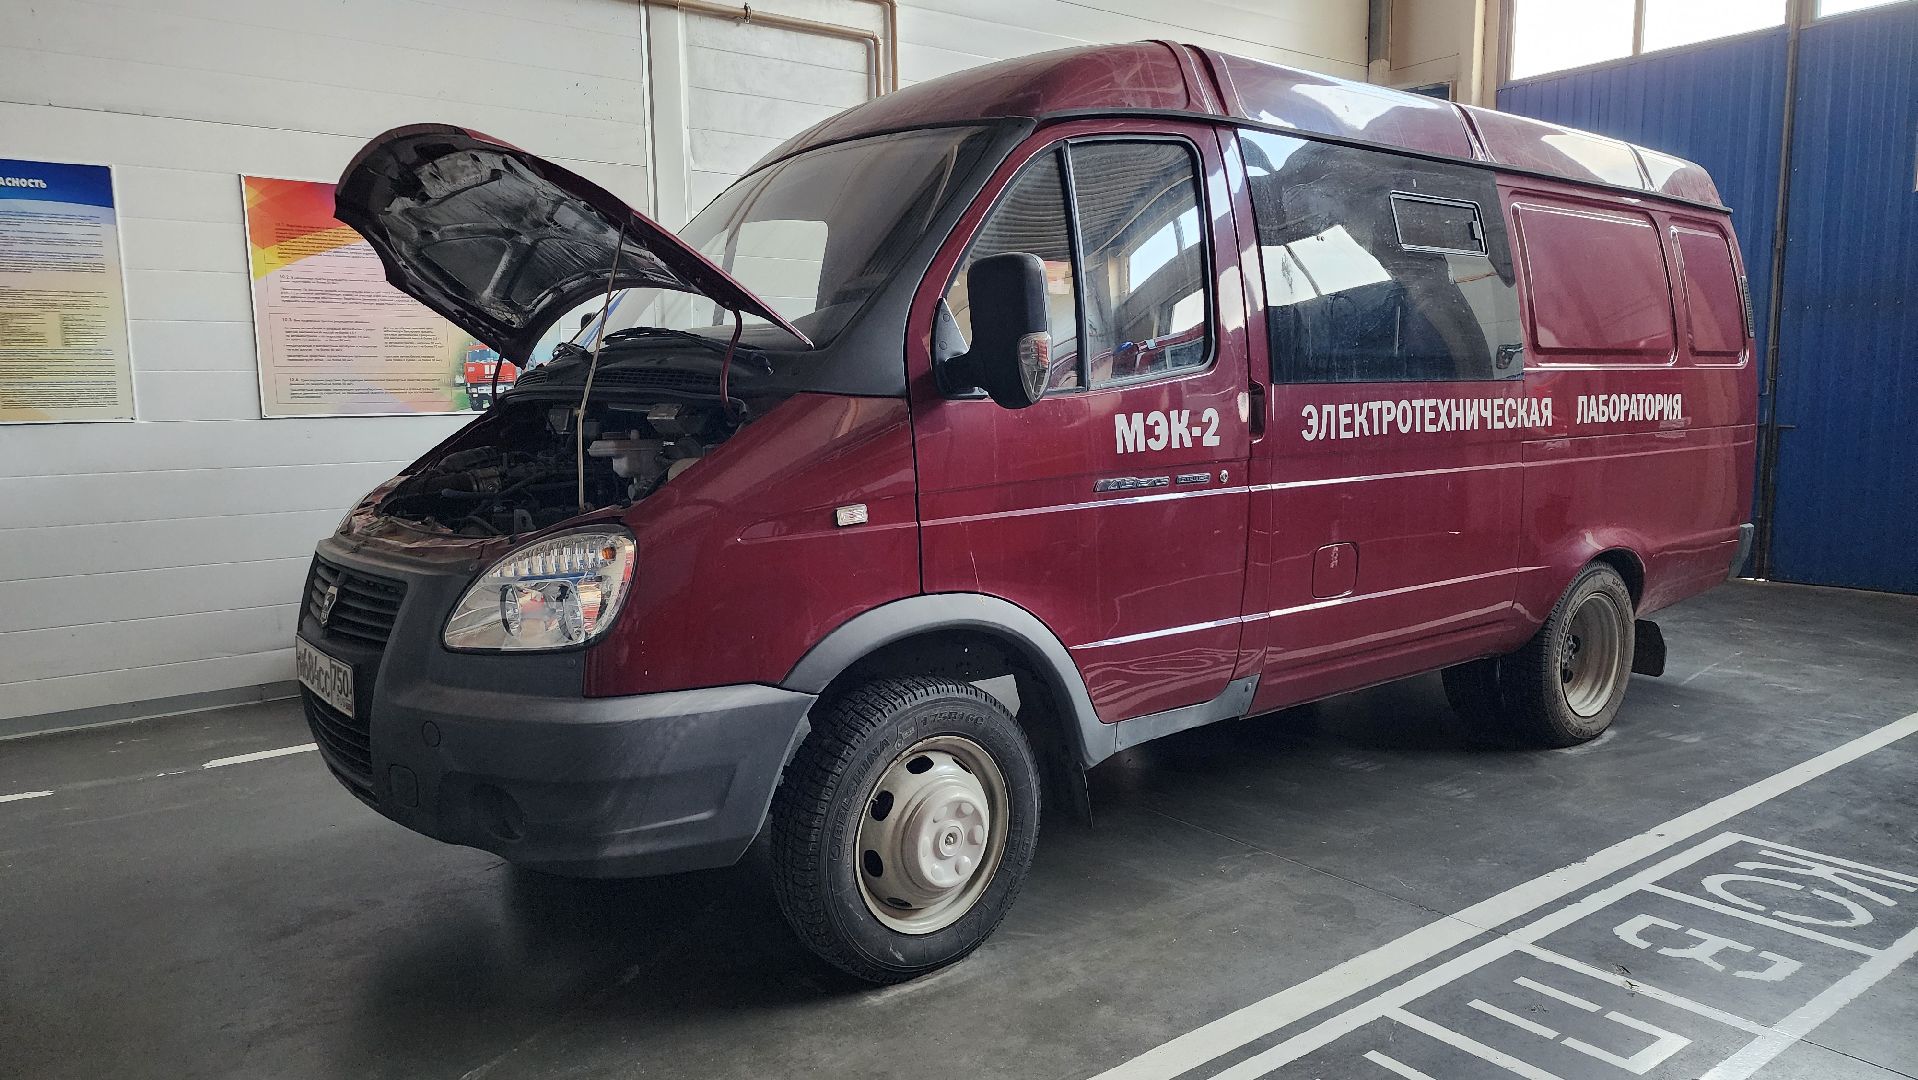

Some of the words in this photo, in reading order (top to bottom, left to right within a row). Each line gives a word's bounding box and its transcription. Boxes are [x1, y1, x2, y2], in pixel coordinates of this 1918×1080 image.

[1114, 407, 1221, 454] МЭК-2
[1301, 397, 1553, 441] ЭЛЕКТРОТЕХНИЧЕСКАЯ
[1576, 393, 1682, 425] ЛАБОРАТОРИЯ
